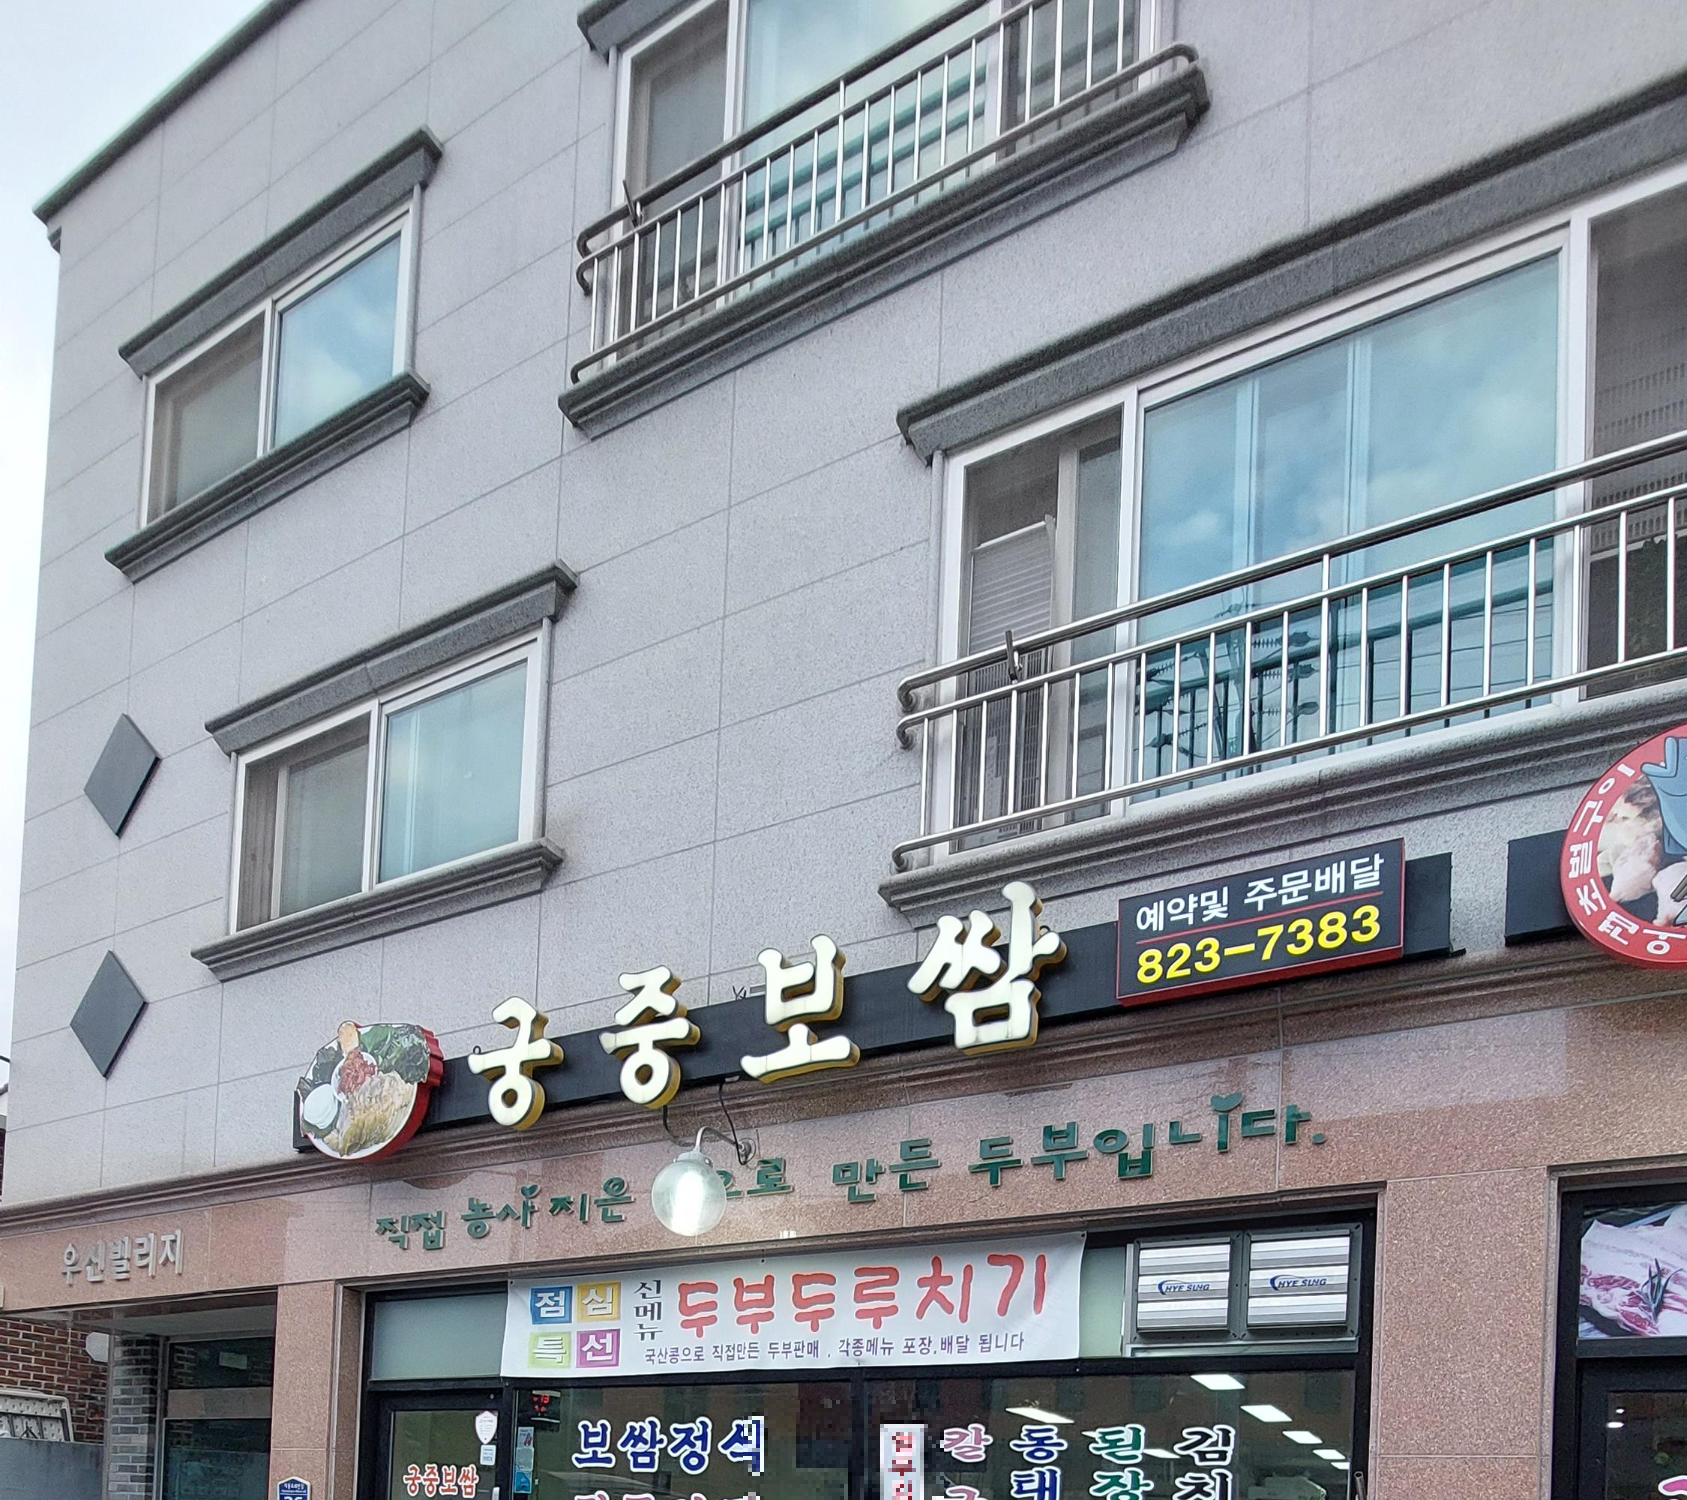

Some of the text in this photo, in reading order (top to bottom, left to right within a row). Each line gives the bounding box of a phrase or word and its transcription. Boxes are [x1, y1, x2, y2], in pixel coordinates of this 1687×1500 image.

[1136, 853, 1385, 932] 예약및 주문배달
[1136, 905, 1381, 984] 823-7383
[467, 882, 1066, 1130] 궁중보쌈
[375, 1211, 446, 1250] 직접
[832, 1138, 942, 1203] 만든
[968, 1092, 1327, 1188] 두부입니다.
[533, 1284, 614, 1318] 점심
[633, 1280, 663, 1341] 신메뉴
[677, 1254, 1047, 1339] 두부두루치기
[532, 1332, 615, 1363] 특선
[645, 1346, 705, 1365] 국산콩으로
[712, 1342, 759, 1363] 직접만든
[767, 1339, 820, 1360] 두부판매
[838, 1337, 894, 1357] 각종메뉴
[978, 1332, 1025, 1354] 됩니다
[572, 1416, 764, 1475] 보쌈정식
[403, 1464, 479, 1498] 궁중보쌈
